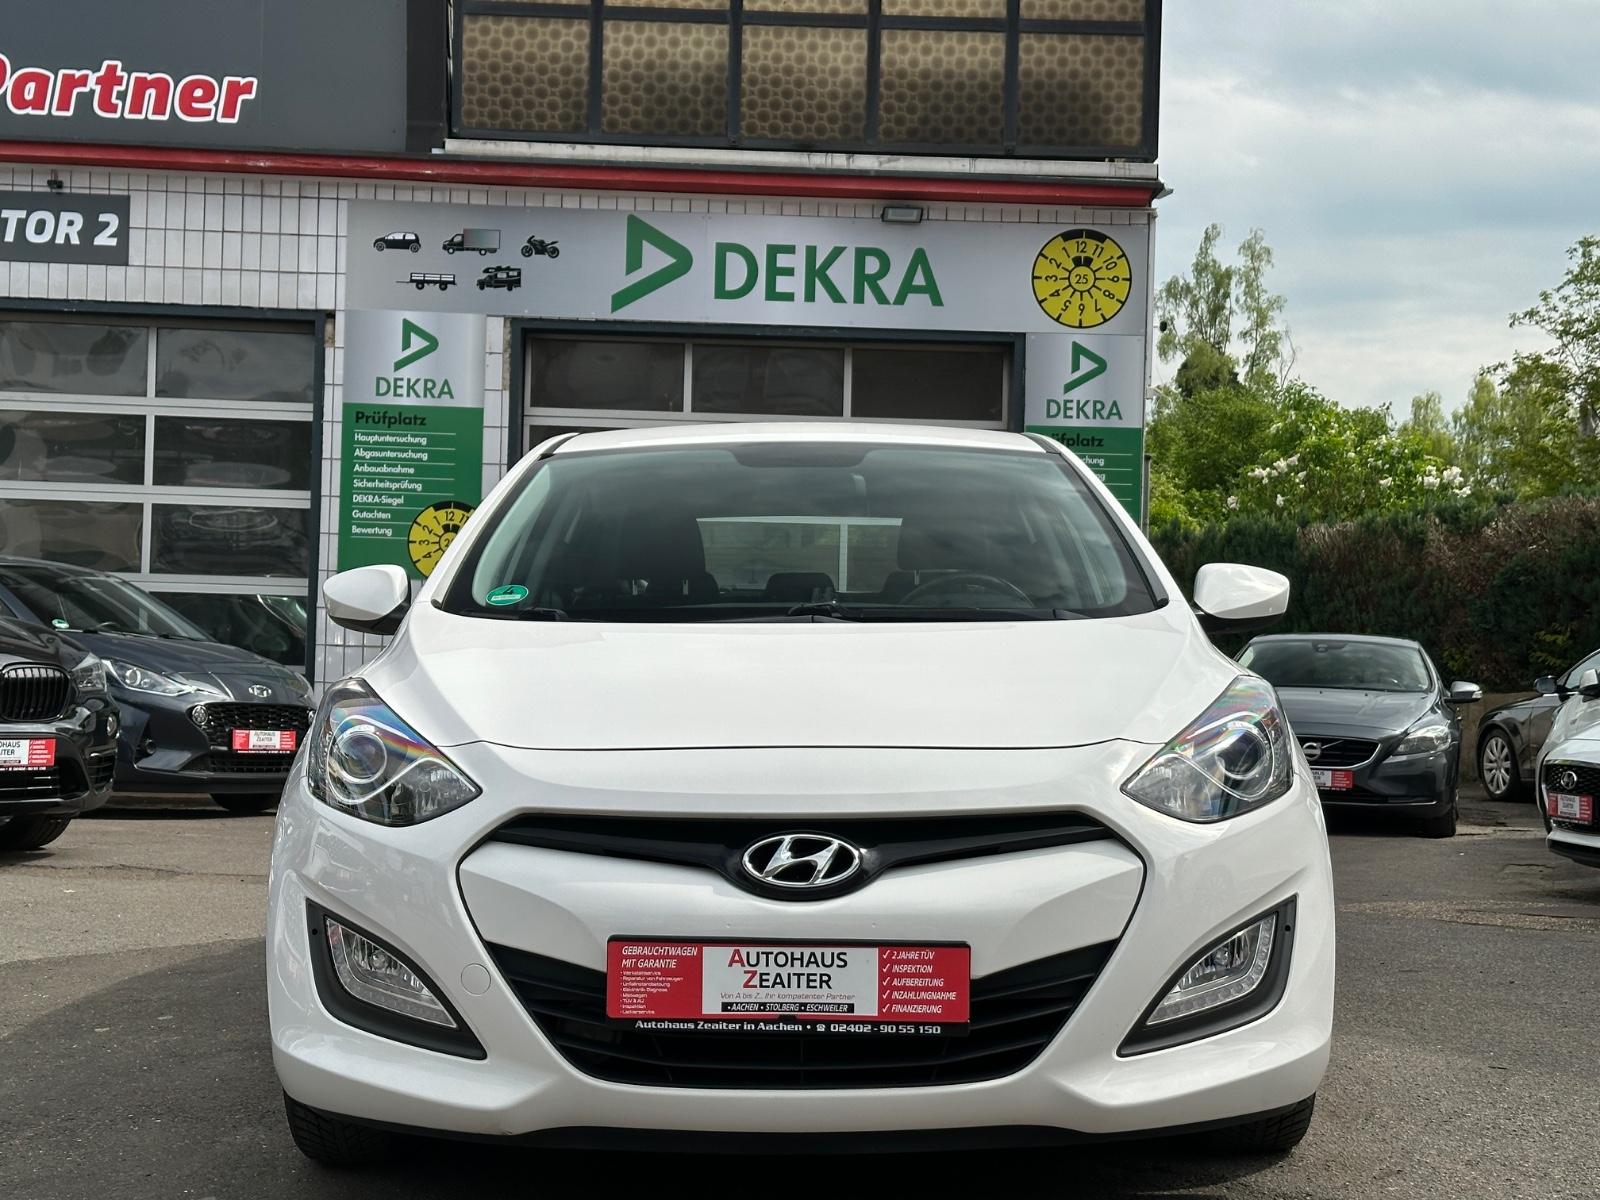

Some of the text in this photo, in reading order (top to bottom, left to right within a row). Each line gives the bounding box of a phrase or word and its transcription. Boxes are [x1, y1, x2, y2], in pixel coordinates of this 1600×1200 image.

[0, 53, 257, 123] artner
[1, 209, 119, 246] TOR 2
[1062, 247, 1070, 258] 1
[1075, 241, 1087, 253] 12
[1092, 244, 1104, 258] 11
[1049, 257, 1062, 269] 2
[1103, 255, 1117, 270] 10
[714, 241, 944, 307] DEKRA
[1045, 274, 1058, 282] 3
[1075, 273, 1089, 285] 25
[1049, 289, 1061, 297] 4
[1102, 289, 1115, 300] 8
[1061, 299, 1072, 312] 5
[1094, 299, 1102, 312] 7
[375, 376, 455, 399] DEKRA
[1045, 398, 1123, 420] DEKRA
[355, 410, 427, 428] Prüfplatz
[354, 432, 427, 446] Hauptuntersuchung
[1052, 433, 1104, 448] fplatz
[354, 447, 428, 461] Abgasuntersuchung
[353, 463, 415, 474] Anbauabnahme
[353, 478, 422, 491] Sicherheitsprüfung
[352, 494, 404, 506] DEKRA-Siegel
[352, 509, 391, 519] Gutachten
[445, 511, 455, 522] 12
[433, 516, 441, 526] 1
[351, 525, 392, 537] Bewertung
[422, 525, 433, 535] 2
[422, 551, 432, 559] 4
[621, 945, 698, 956] GEBRAUCHTWAGEN
[920, 949, 935, 960] TÜV
[621, 958, 678, 969] MIT GARANTIE
[727, 948, 848, 968] AUTOHAUS
[891, 964, 933, 974] INSPEKTION
[742, 969, 833, 990] ZEAITER
[891, 978, 945, 987] AUFBEREITUNG
[720, 992, 734, 1000] Von
[735, 992, 741, 1000] A
[742, 992, 752, 1000] bis
[777, 992, 825, 1001] kompetenter
[825, 993, 856, 1001] Partner
[891, 991, 957, 1000] INZAHLUNGNAHME
[731, 1003, 848, 1012] AACHEN STOLBERG ESCHWEILER
[891, 1004, 942, 1014] FINANZIERUNG
[634, 1019, 695, 1030] Autohaus
[697, 1020, 742, 1030] Zeaiter
[743, 1021, 755, 1030] in
[756, 1022, 803, 1031] Aachen
[830, 1023, 872, 1033] 02402
[880, 1024, 896, 1033] 90
[898, 1024, 915, 1033] 55
[918, 1025, 941, 1034] 150
